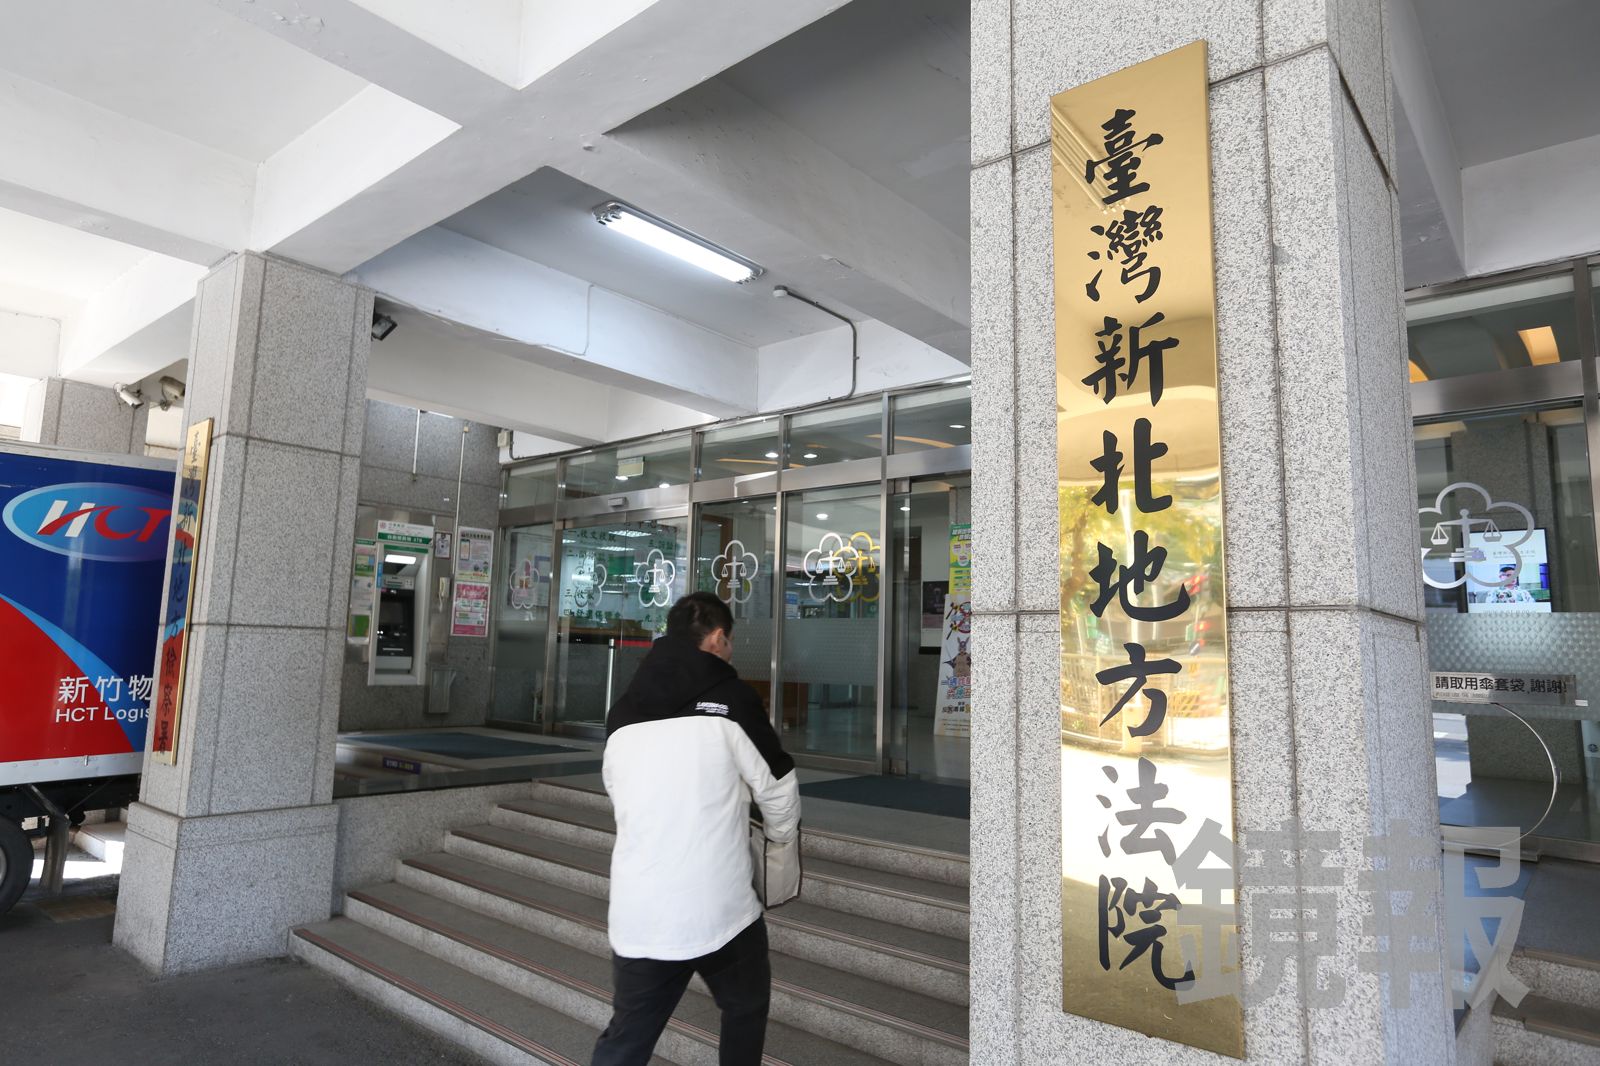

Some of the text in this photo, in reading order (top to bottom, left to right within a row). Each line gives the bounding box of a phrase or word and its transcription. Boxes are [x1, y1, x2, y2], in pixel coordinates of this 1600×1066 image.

[37, 499, 173, 543] HCT
[1081, 108, 1196, 992] 臺灣新北地方法院
[55, 707, 99, 723] HCT
